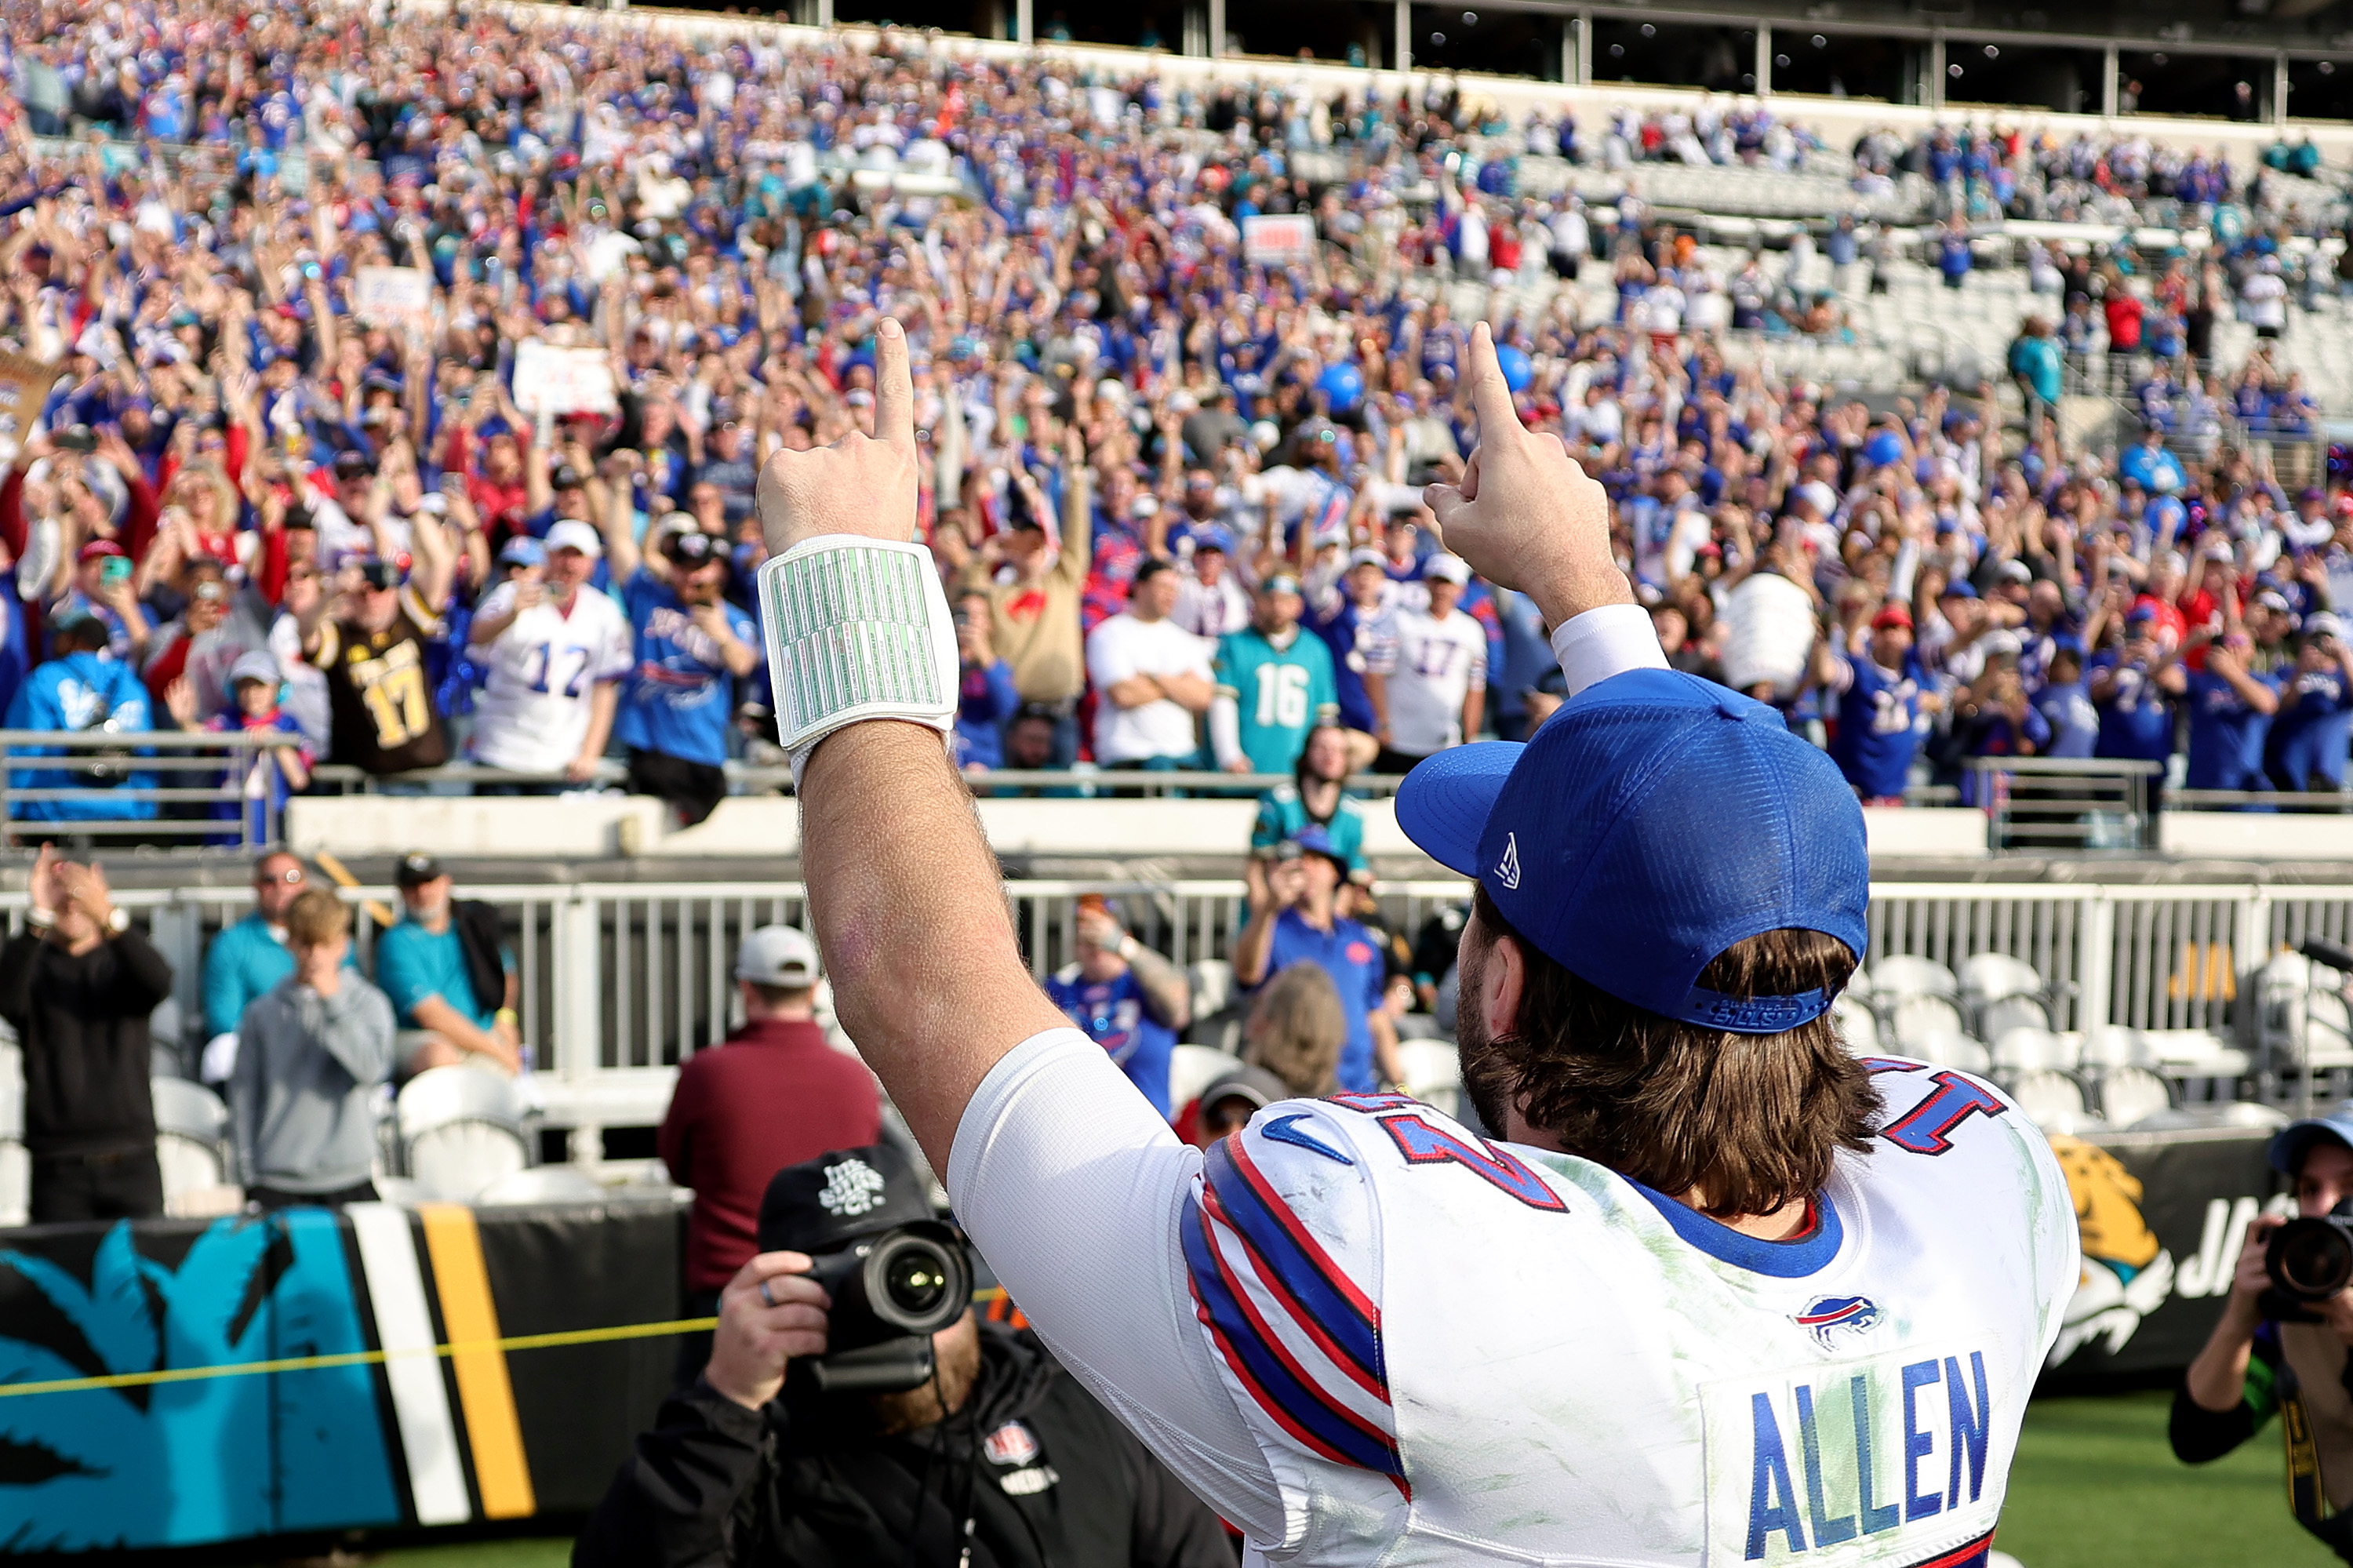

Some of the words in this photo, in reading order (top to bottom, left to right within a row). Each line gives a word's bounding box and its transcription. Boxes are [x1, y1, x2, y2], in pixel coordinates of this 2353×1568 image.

[362, 664, 431, 750] 17
[1255, 661, 1311, 729] 16
[1714, 1008, 1776, 1028] BILLS
[1744, 1350, 1990, 1561] ALLEN
